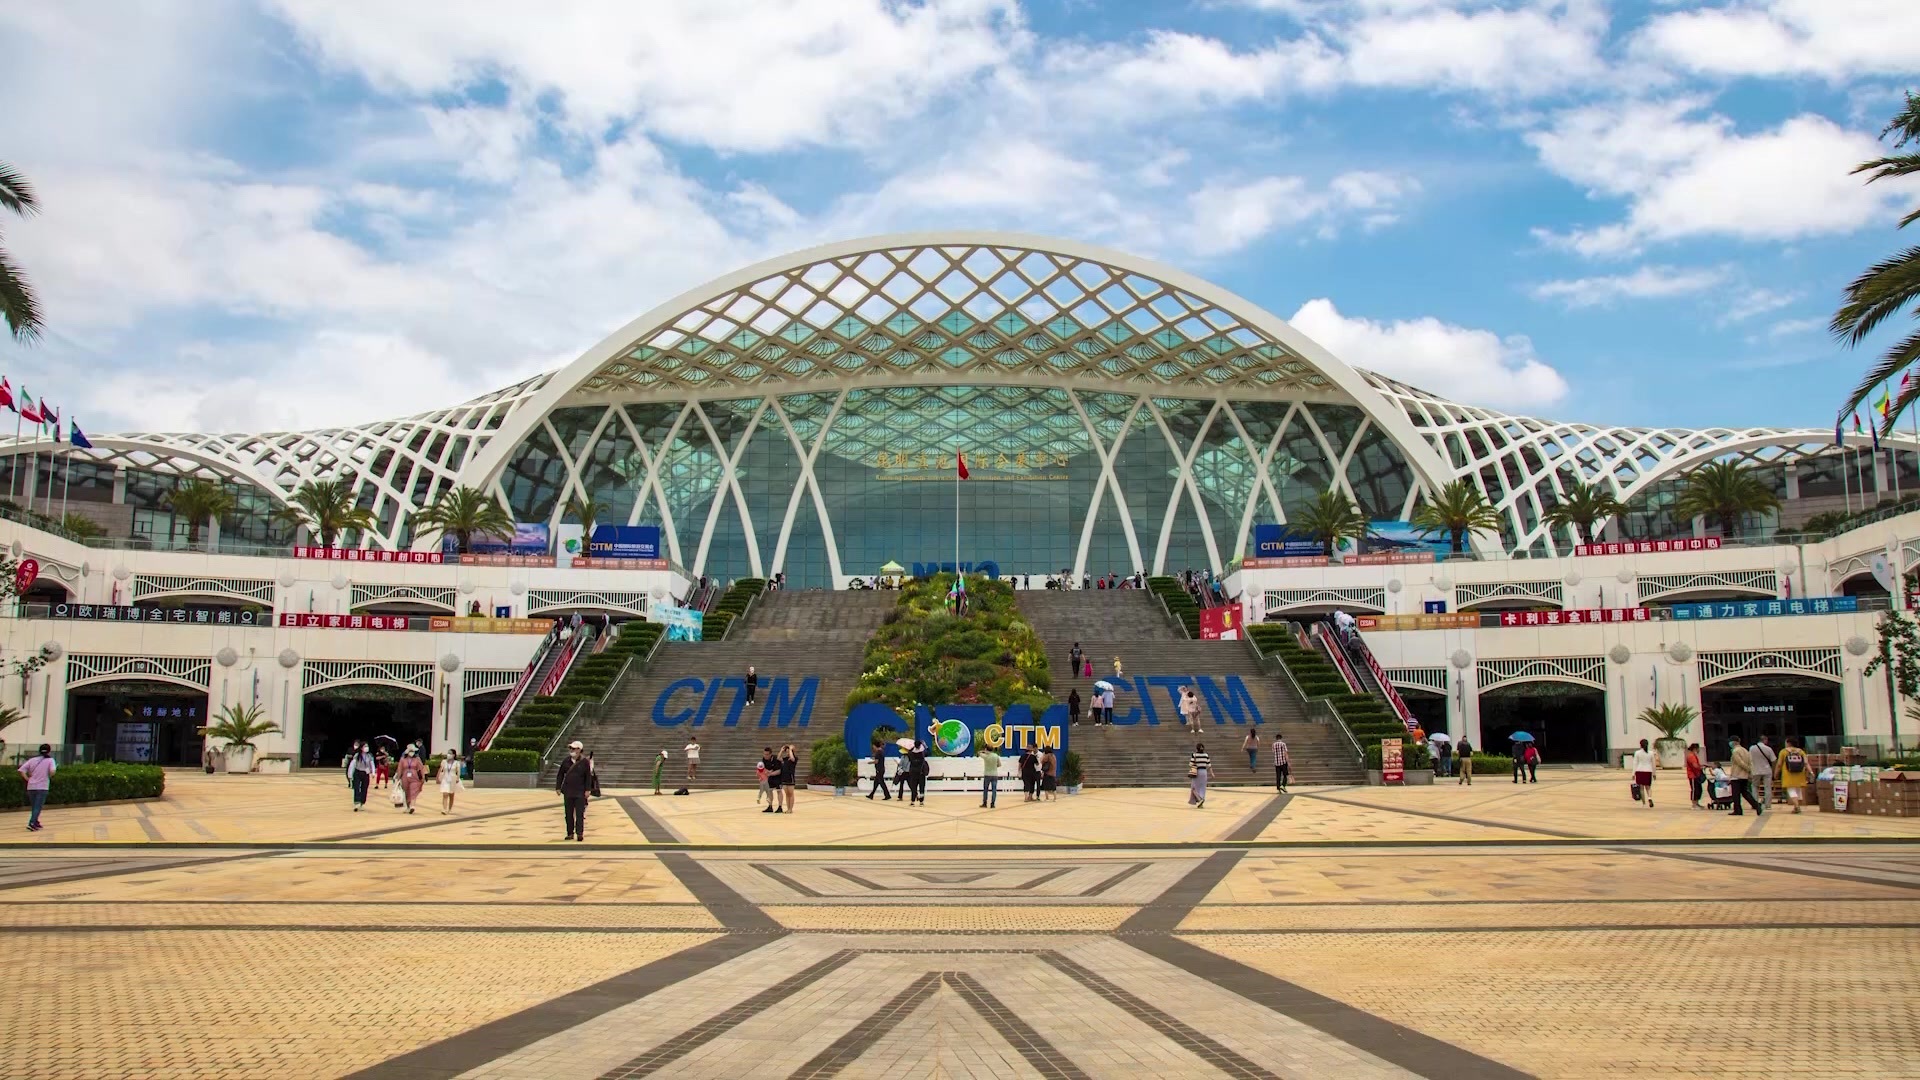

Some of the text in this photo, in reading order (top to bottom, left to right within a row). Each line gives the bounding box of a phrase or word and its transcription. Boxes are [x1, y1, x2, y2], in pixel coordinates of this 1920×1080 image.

[590, 543, 613, 551] CITM
[1261, 542, 1284, 550] CITM
[78, 605, 231, 623] 欧瑞博全宅智能
[1505, 608, 1646, 625] 卡利亚全钢厨柜
[1698, 600, 1829, 618] 通力家用电梯
[285, 615, 405, 629] 日立家用电梯
[651, 675, 821, 728] CITM
[1093, 674, 1265, 726] CITM
[983, 723, 1061, 750] CITM
